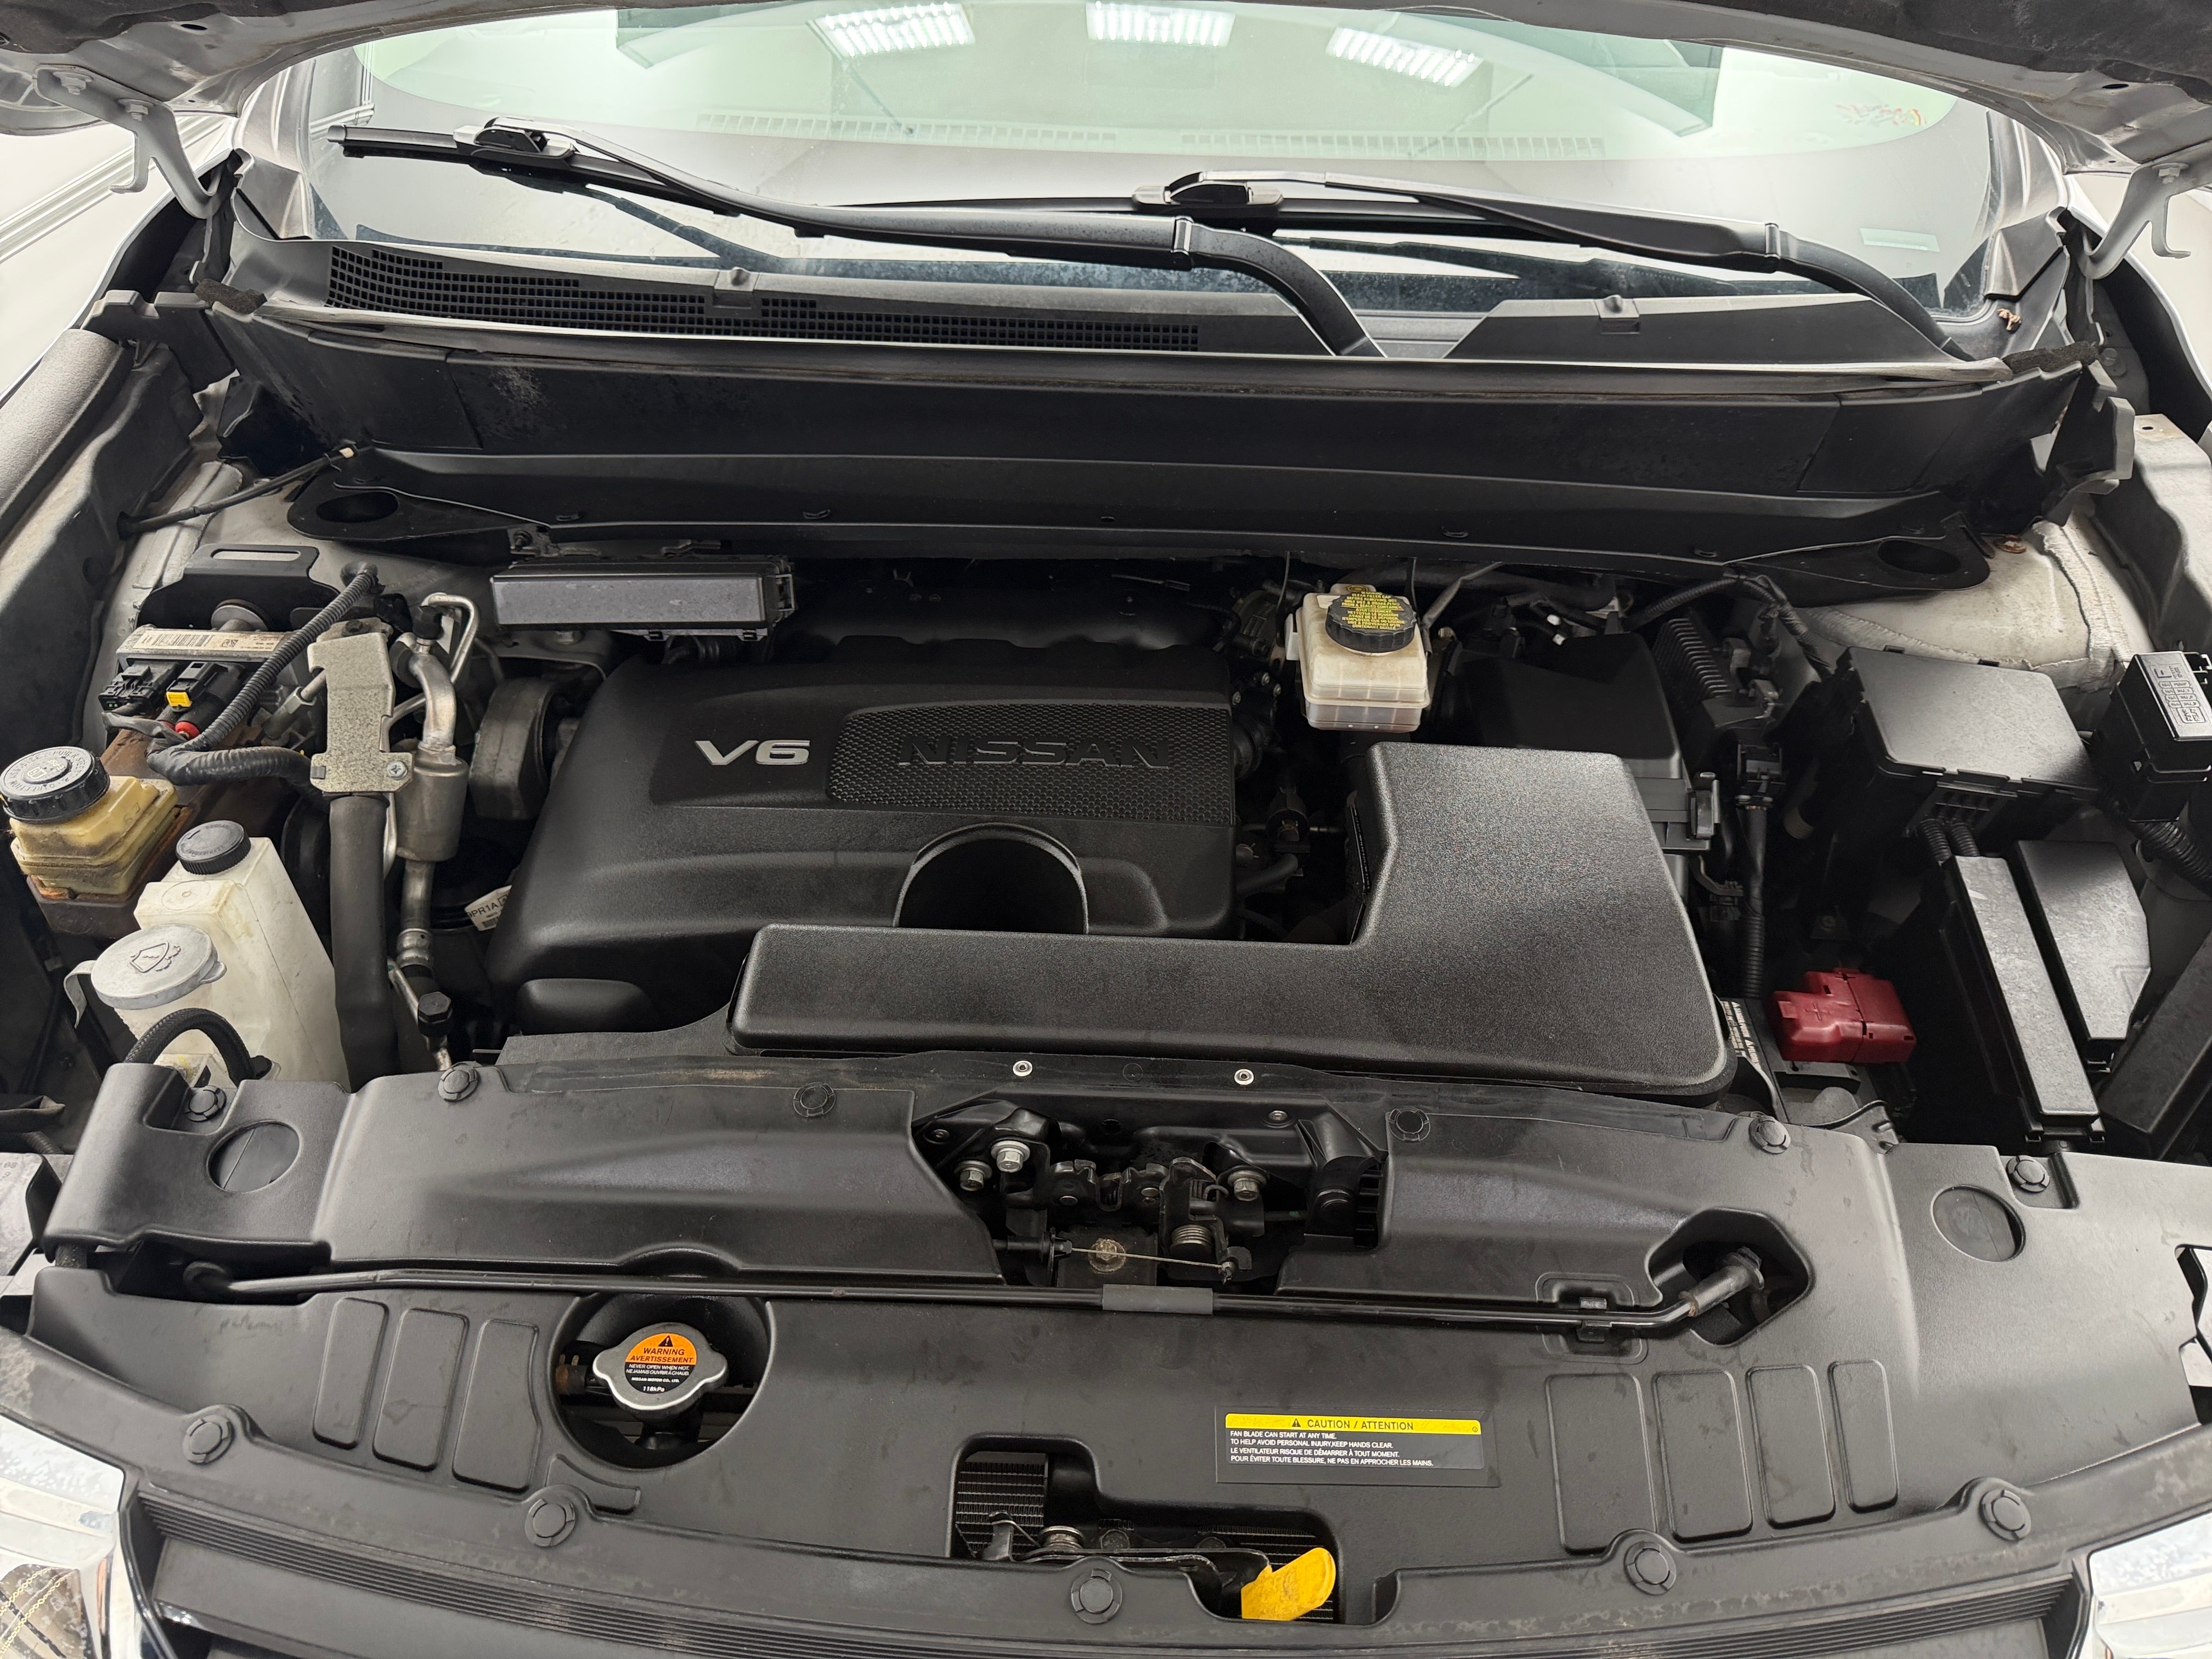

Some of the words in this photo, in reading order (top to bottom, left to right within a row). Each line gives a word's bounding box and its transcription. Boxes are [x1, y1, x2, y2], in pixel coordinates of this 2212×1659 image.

[695, 740, 811, 765] V6
[898, 735, 1169, 770] NISSAN
[643, 1347, 685, 1356] WARNING
[630, 1355, 693, 1363] AVERTISSEMENT
[1307, 1419, 1350, 1429] CAUTION
[1361, 1421, 1414, 1430] ATTENTION
[1313, 1448, 1347, 1456] DÉMARRER
[1250, 1454, 1271, 1463] ÉVITER
